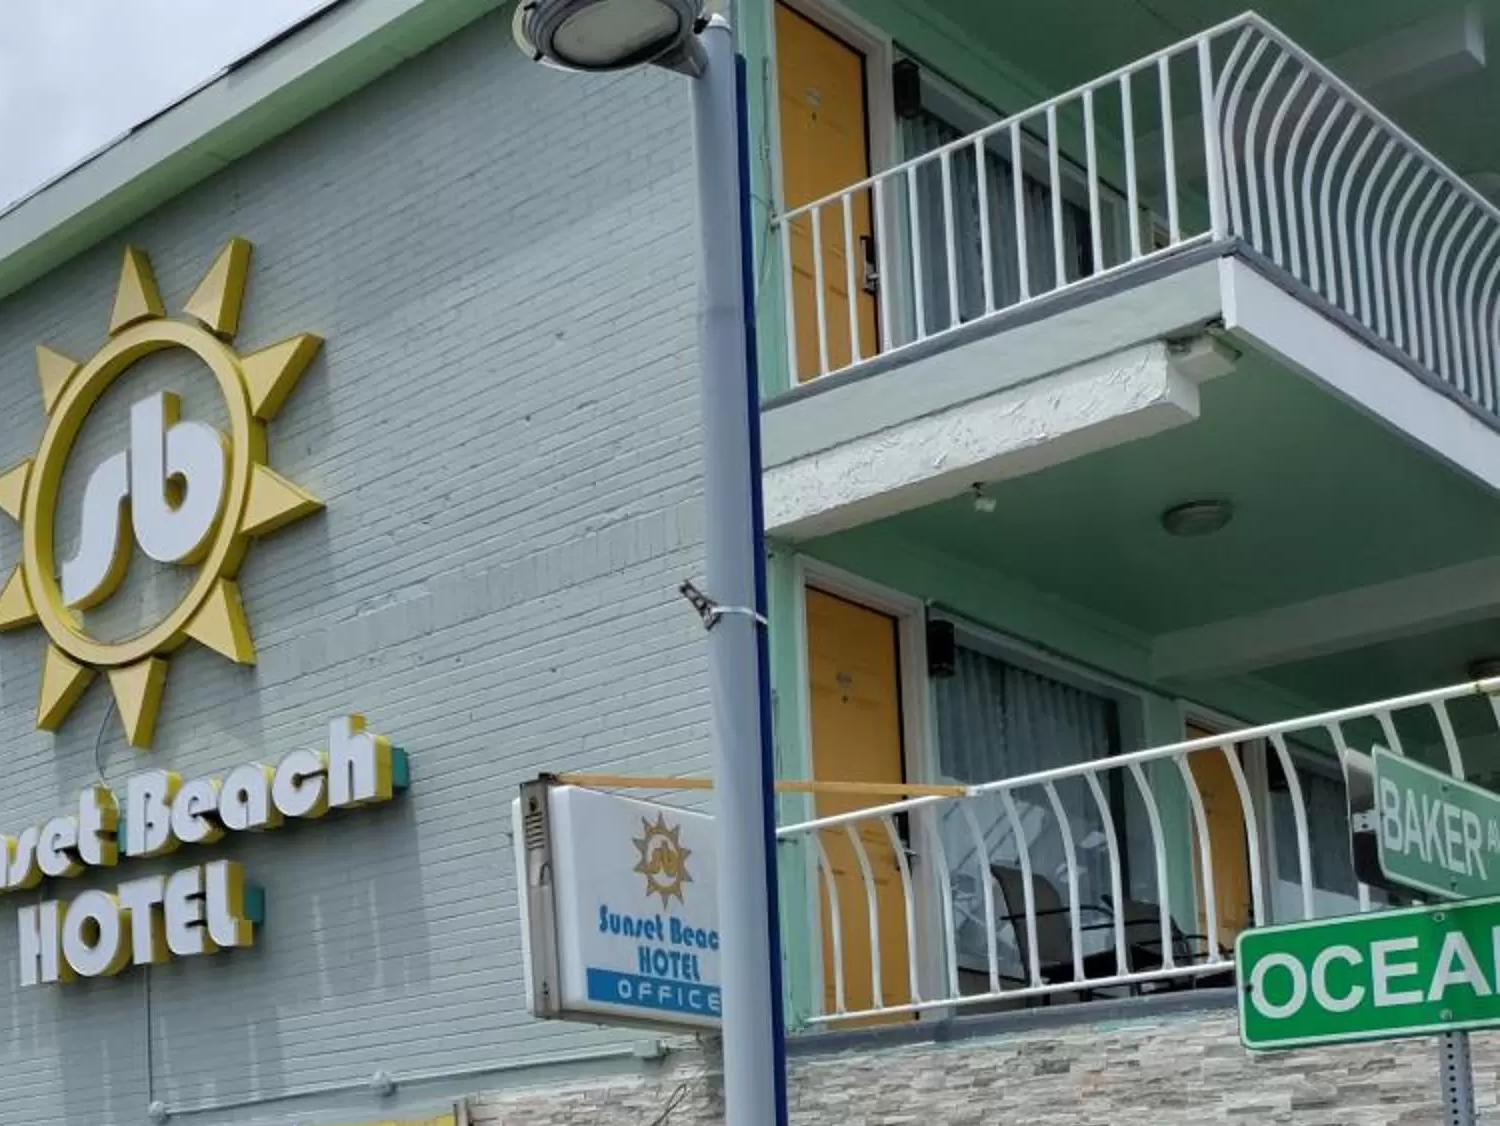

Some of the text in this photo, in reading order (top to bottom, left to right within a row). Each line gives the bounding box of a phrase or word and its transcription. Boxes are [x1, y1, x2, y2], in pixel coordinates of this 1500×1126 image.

[126, 713, 386, 857] Beach
[1380, 776, 1500, 881] BAKER A
[18, 860, 250, 987] HOTEL
[599, 904, 720, 951] Sunset Beac
[638, 945, 700, 982] HOTEL
[617, 979, 721, 1011] OFFICE
[1250, 926, 1500, 1019] OCEA
